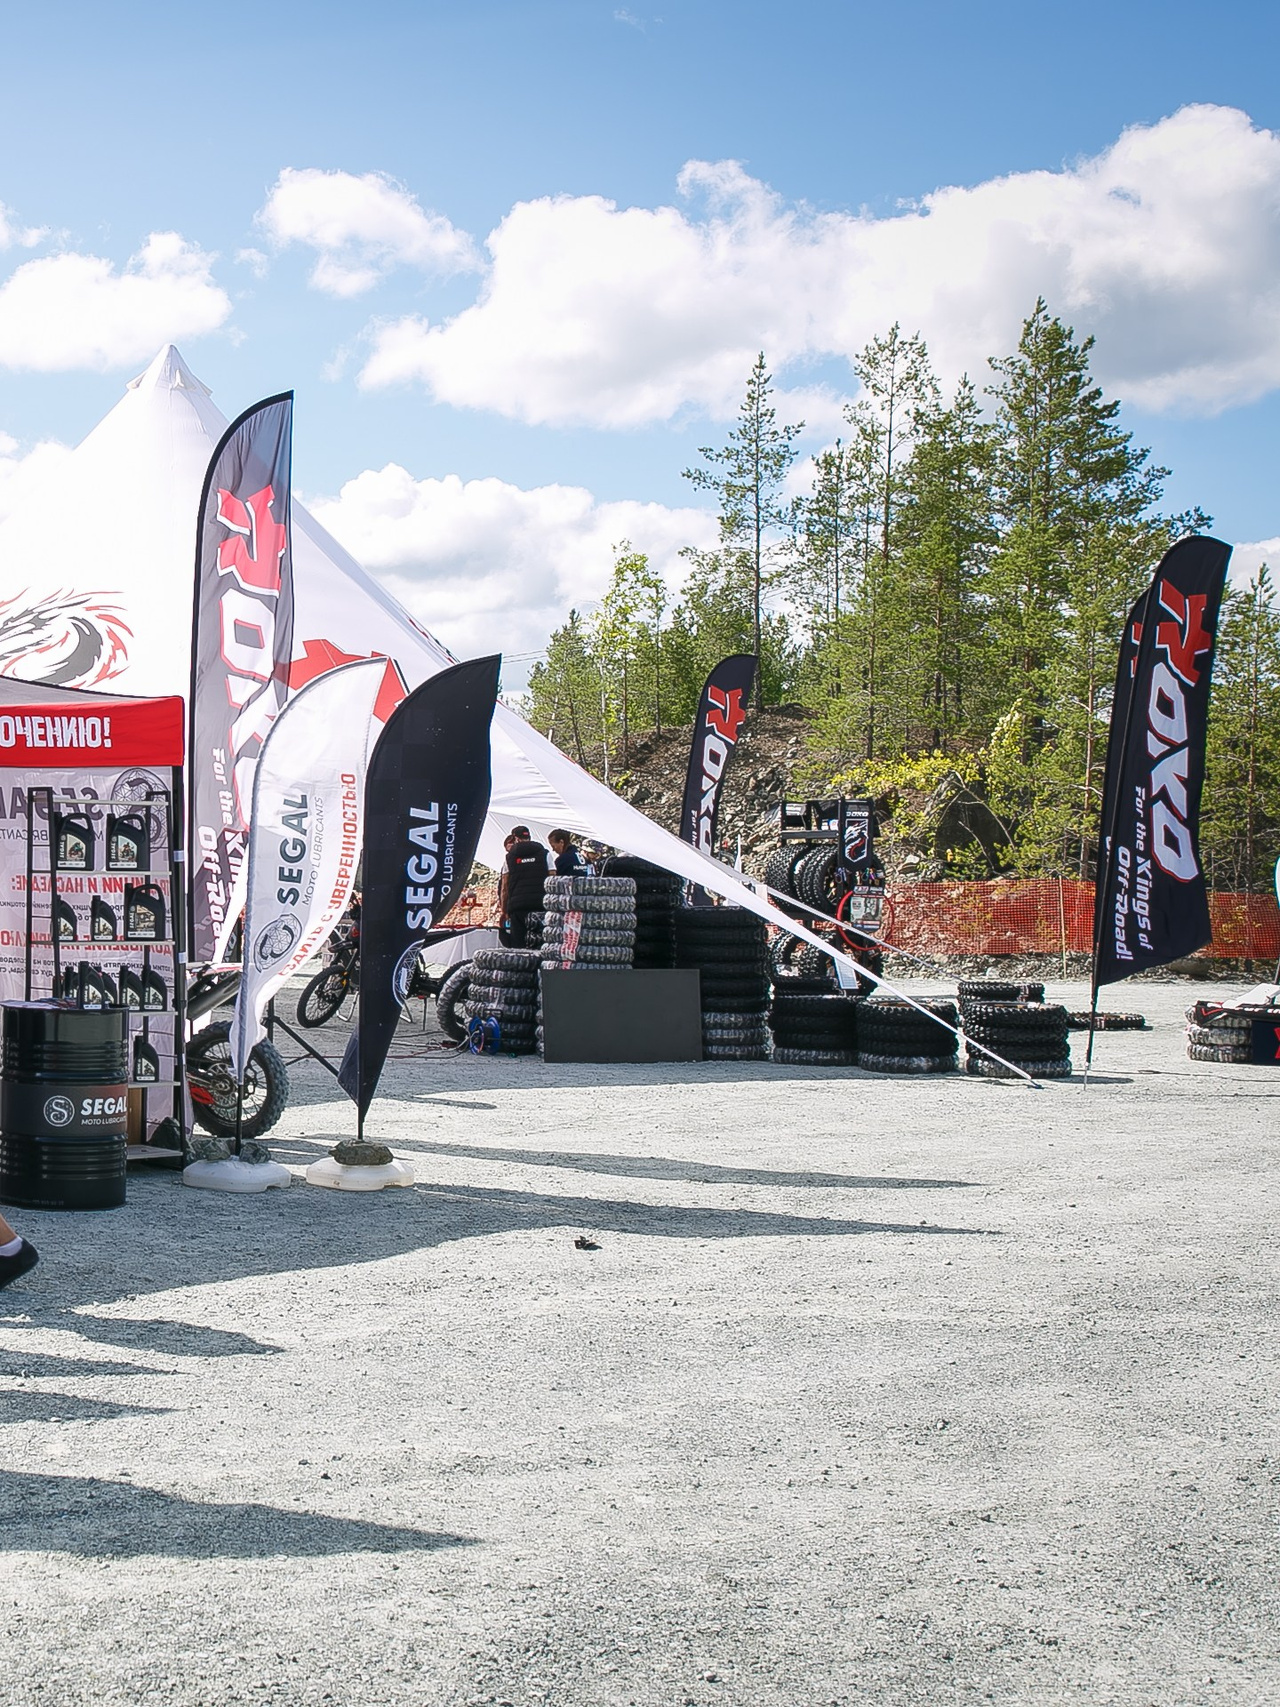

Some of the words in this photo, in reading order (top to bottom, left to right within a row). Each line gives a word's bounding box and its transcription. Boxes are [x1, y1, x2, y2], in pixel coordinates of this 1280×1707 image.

[1147, 579, 1213, 883] ROXO
[308, 796, 323, 866] LUBRICANTS
[1134, 786, 1146, 819] For
[1135, 822, 1147, 852] the
[276, 793, 310, 907] SEGAL
[329, 773, 356, 911] УВЕРЕННОСТЬЮ
[406, 801, 439, 931] SEGAL
[442, 802, 458, 884] LUBRICANTS
[302, 868, 319, 905] MOTO
[1132, 856, 1153, 929] Kings
[1139, 932, 1154, 950] of
[81, 1118, 101, 1126] MOTO
